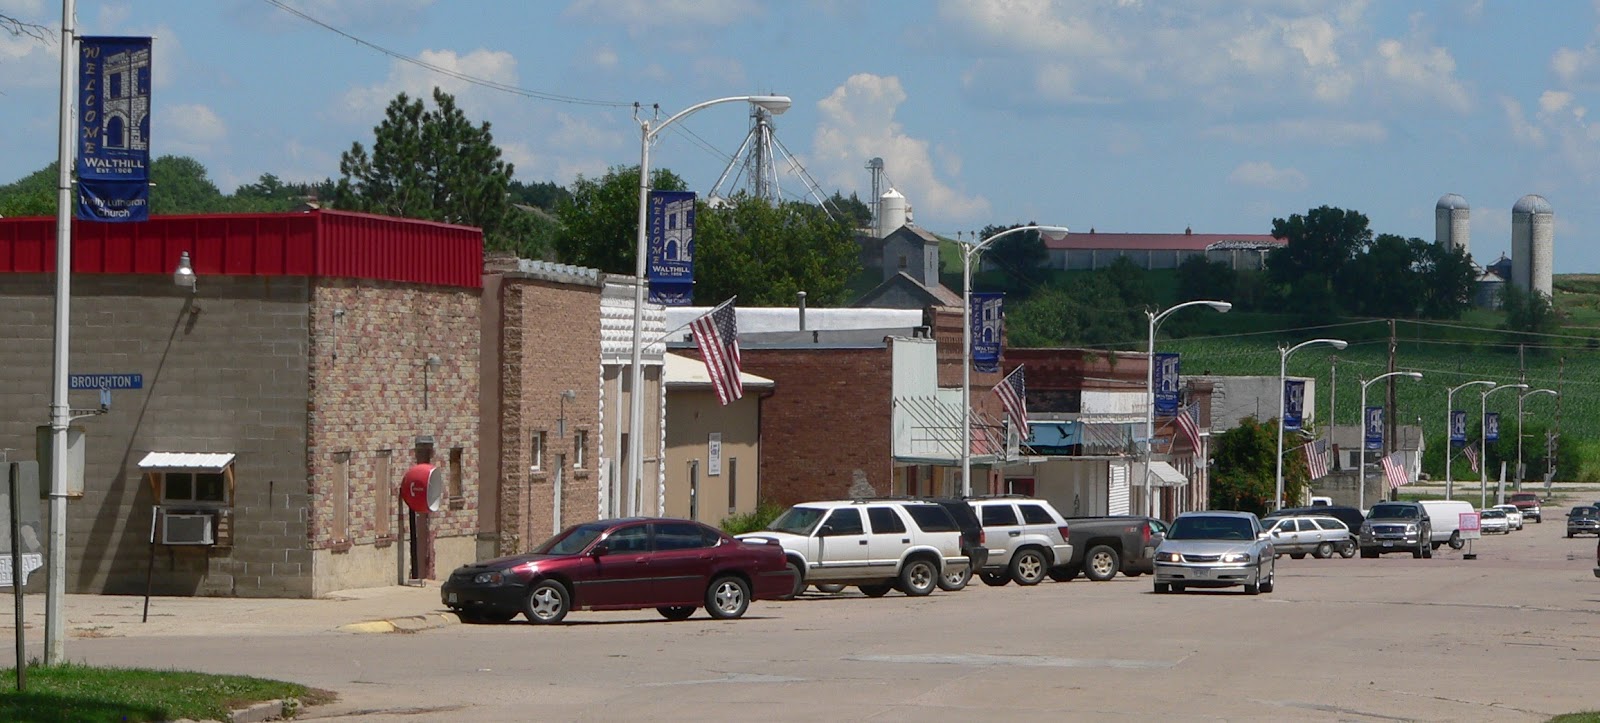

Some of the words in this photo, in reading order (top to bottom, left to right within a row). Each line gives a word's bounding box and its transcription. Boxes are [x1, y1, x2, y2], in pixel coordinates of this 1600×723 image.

[82, 46, 100, 154] WELCOME
[84, 158, 144, 168] WALTHILL
[107, 198, 146, 207] Lutheran
[98, 208, 130, 218] Church
[652, 196, 664, 264] WELCOME
[652, 265, 690, 273] WALTHILL
[71, 376, 132, 388] BROUGHTON
